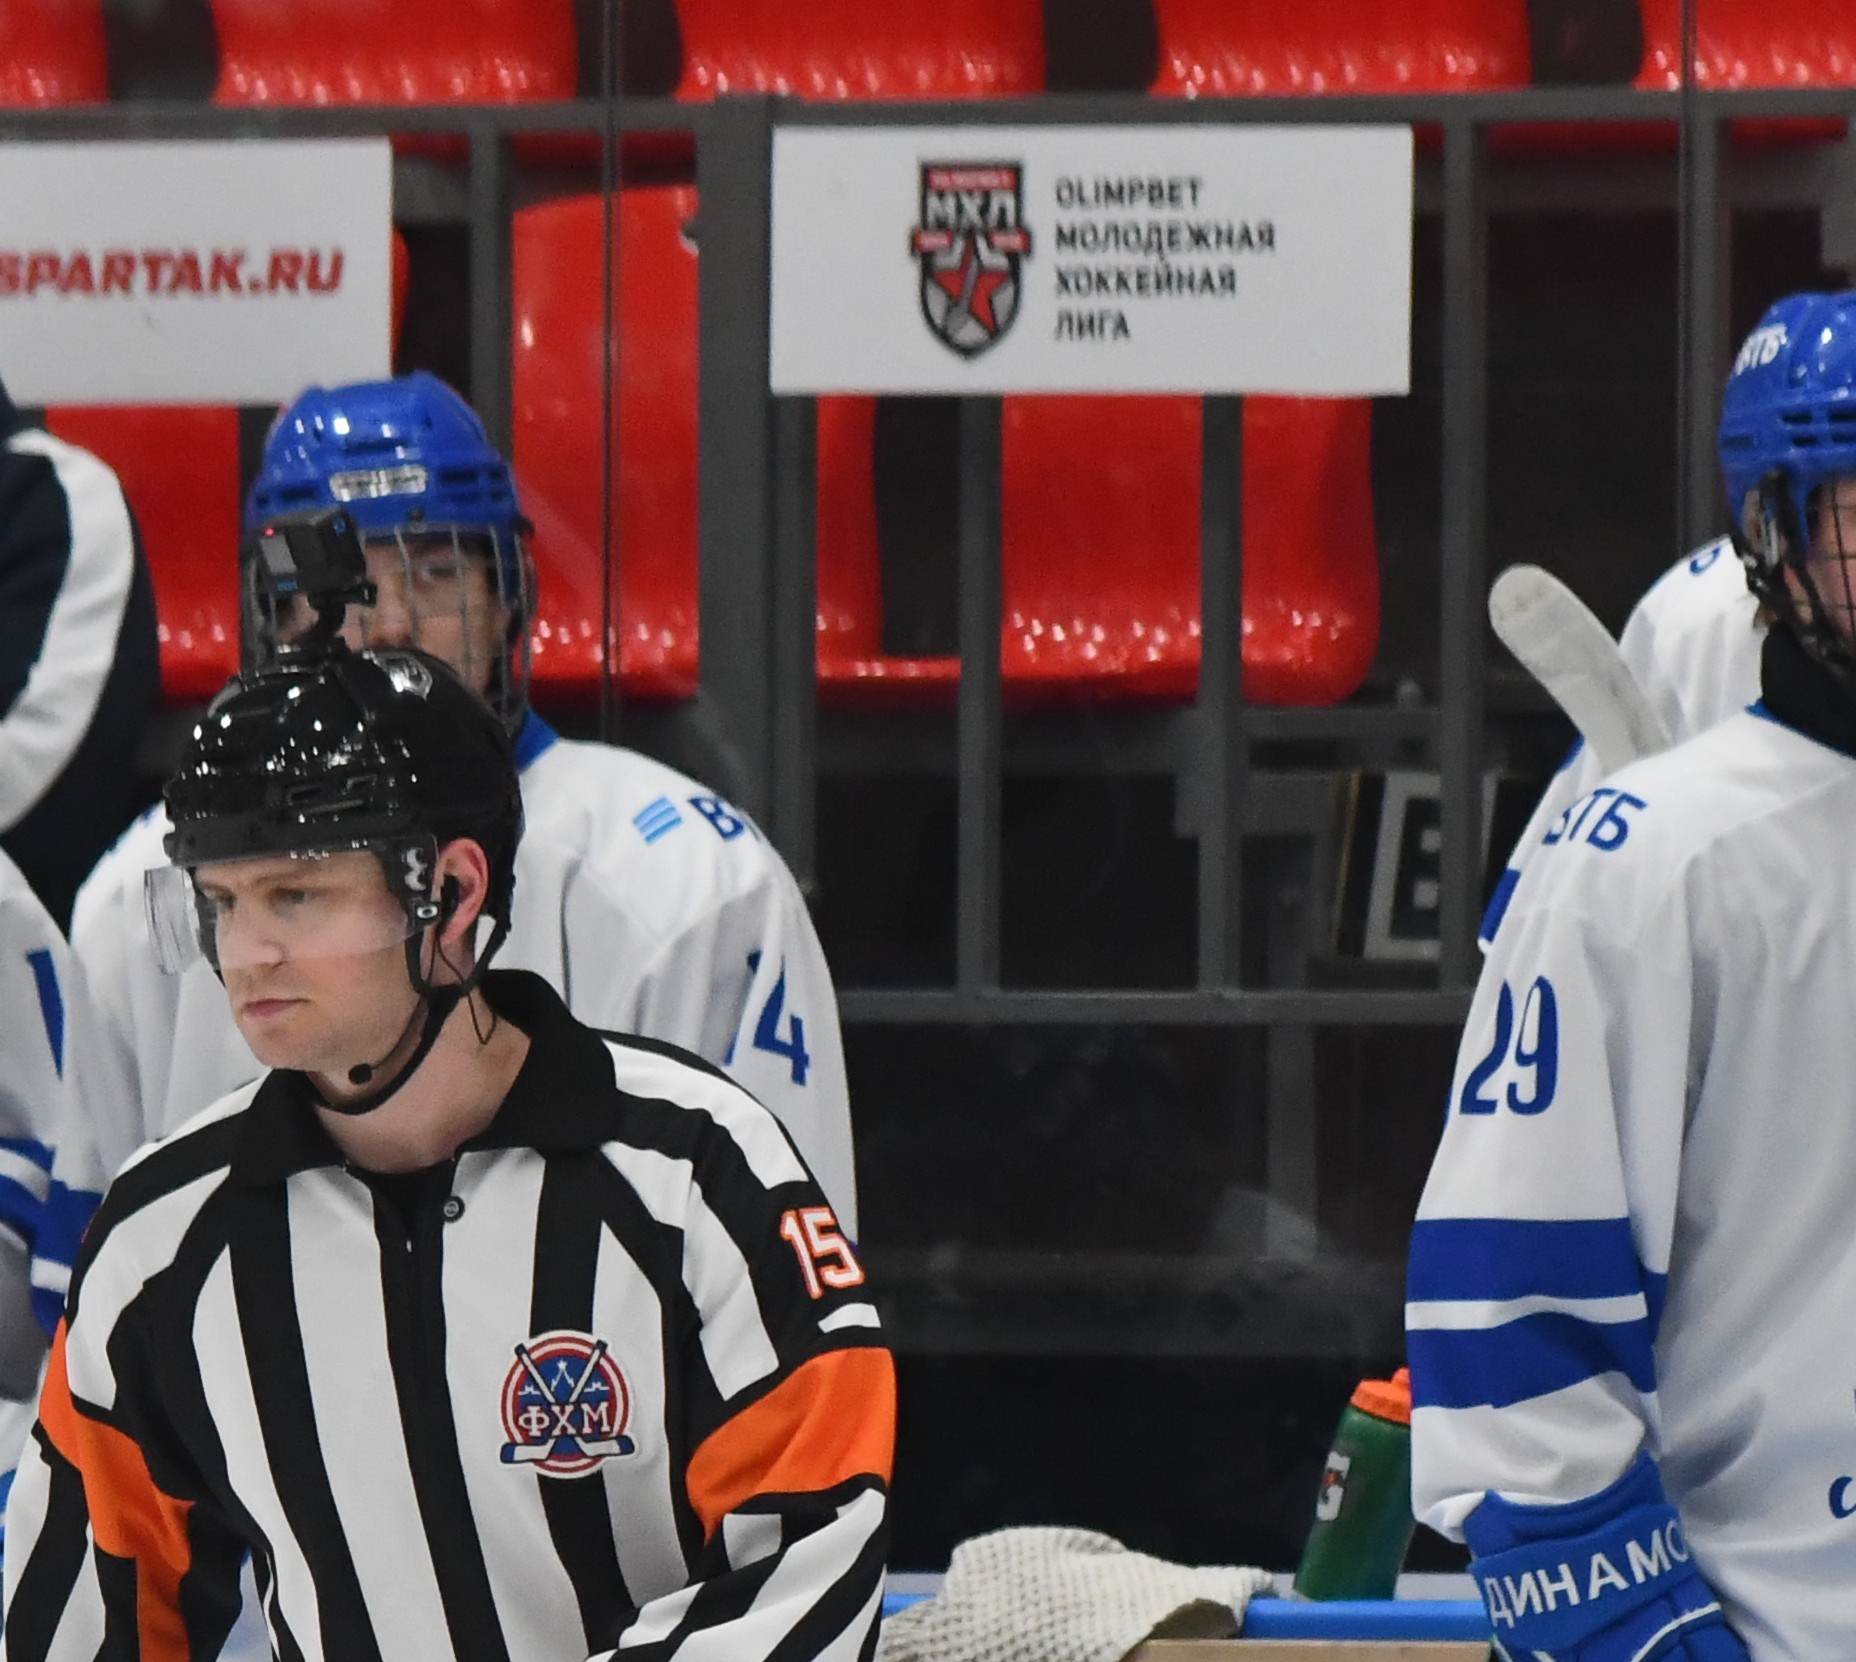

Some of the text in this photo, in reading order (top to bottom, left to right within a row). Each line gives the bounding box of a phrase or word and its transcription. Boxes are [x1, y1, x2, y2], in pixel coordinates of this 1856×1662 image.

[1054, 175, 1204, 210] OLIMPBET
[1054, 219, 1277, 258] МОЛОДЕЖНАЯ
[1053, 259, 1239, 298] ХОККЕЙНАЯ
[1054, 308, 1132, 342] ЛИГА
[1459, 974, 1559, 1116] 29
[779, 1205, 865, 1299] 15
[518, 1404, 613, 1437] ФХМ
[1483, 1518, 1692, 1631] ДИНАМО
